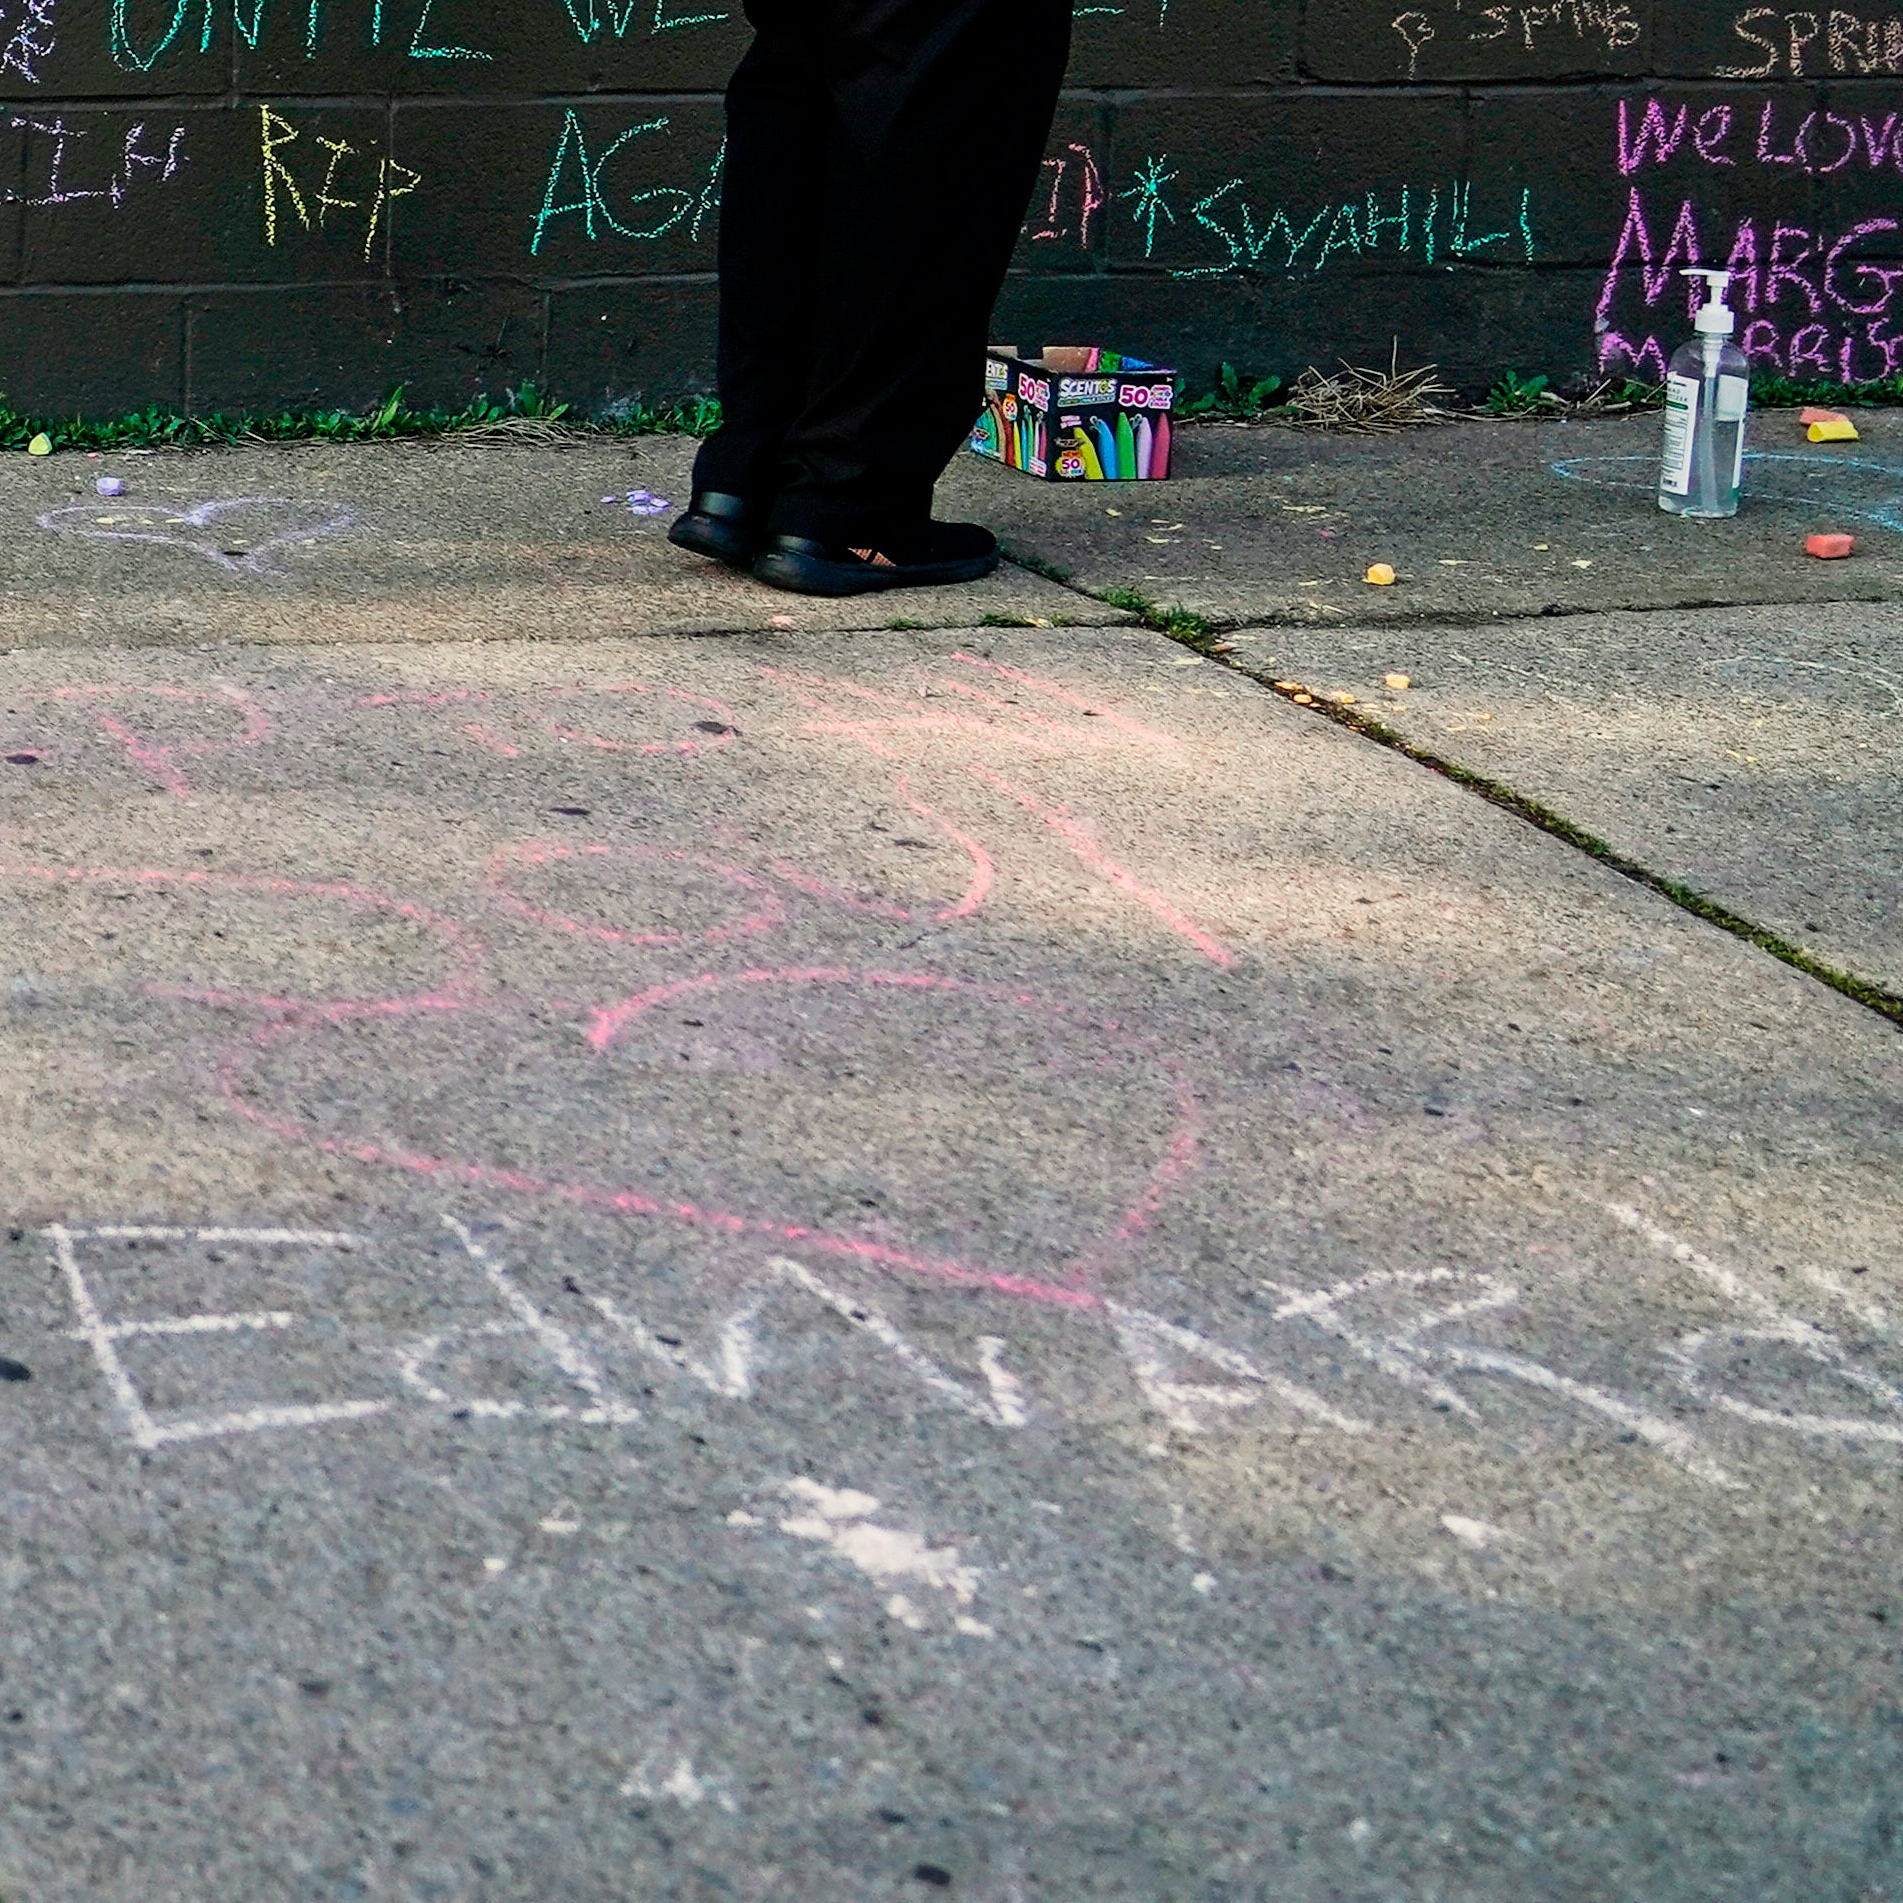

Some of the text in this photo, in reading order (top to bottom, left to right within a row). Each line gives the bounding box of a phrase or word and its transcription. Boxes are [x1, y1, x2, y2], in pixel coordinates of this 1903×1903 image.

[260, 103, 424, 265] RIP
[1059, 377, 1117, 398] SCENTOS
[1120, 385, 1149, 405] 50
